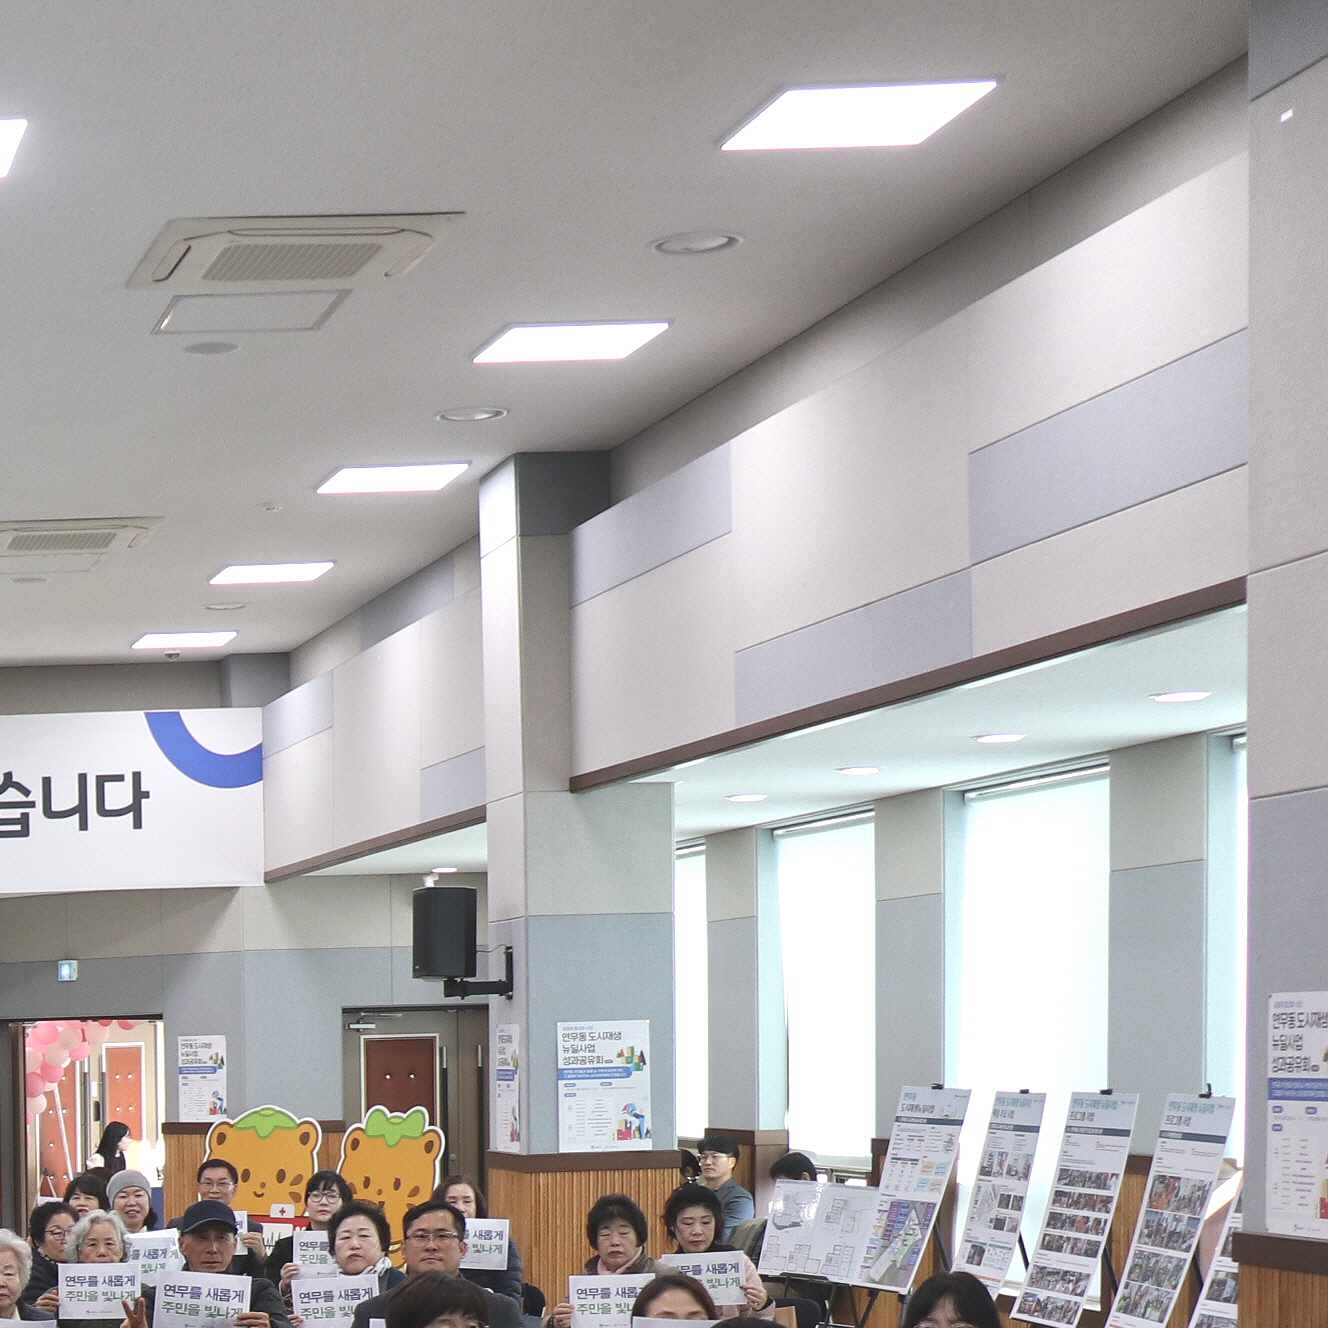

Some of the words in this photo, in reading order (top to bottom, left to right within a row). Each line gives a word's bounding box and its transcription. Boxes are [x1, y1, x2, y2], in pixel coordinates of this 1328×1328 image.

[1272, 1012, 1295, 1030] 연무동
[562, 1032, 587, 1042] 연무동
[588, 1031, 622, 1041] 도시재생
[1272, 1033, 1303, 1050] 뉴딜사업
[562, 1044, 595, 1053] 뉴딜사업
[562, 1055, 604, 1065] 성과공유회
[473, 1229, 504, 1240] 새롭게
[299, 1240, 329, 1251] 연무를
[473, 1242, 503, 1254] 빛나게
[299, 1253, 328, 1265] 주민을
[705, 1262, 739, 1274] 새롭게
[64, 1274, 98, 1287] 연무를
[101, 1274, 135, 1287] 새롭게
[706, 1276, 741, 1288] 빛나게
[64, 1290, 98, 1302] 주민을
[101, 1290, 136, 1301] 빛나게
[163, 1283, 202, 1299] 연무를
[205, 1287, 245, 1303] 새롭게
[299, 1290, 335, 1304] 연무를
[338, 1287, 373, 1300] 새롭게
[576, 1287, 611, 1300] 연무를
[162, 1301, 201, 1317] 주민을
[203, 1303, 243, 1319] 빛나게
[299, 1305, 335, 1319] 주민을
[576, 1302, 612, 1315] 주민을
